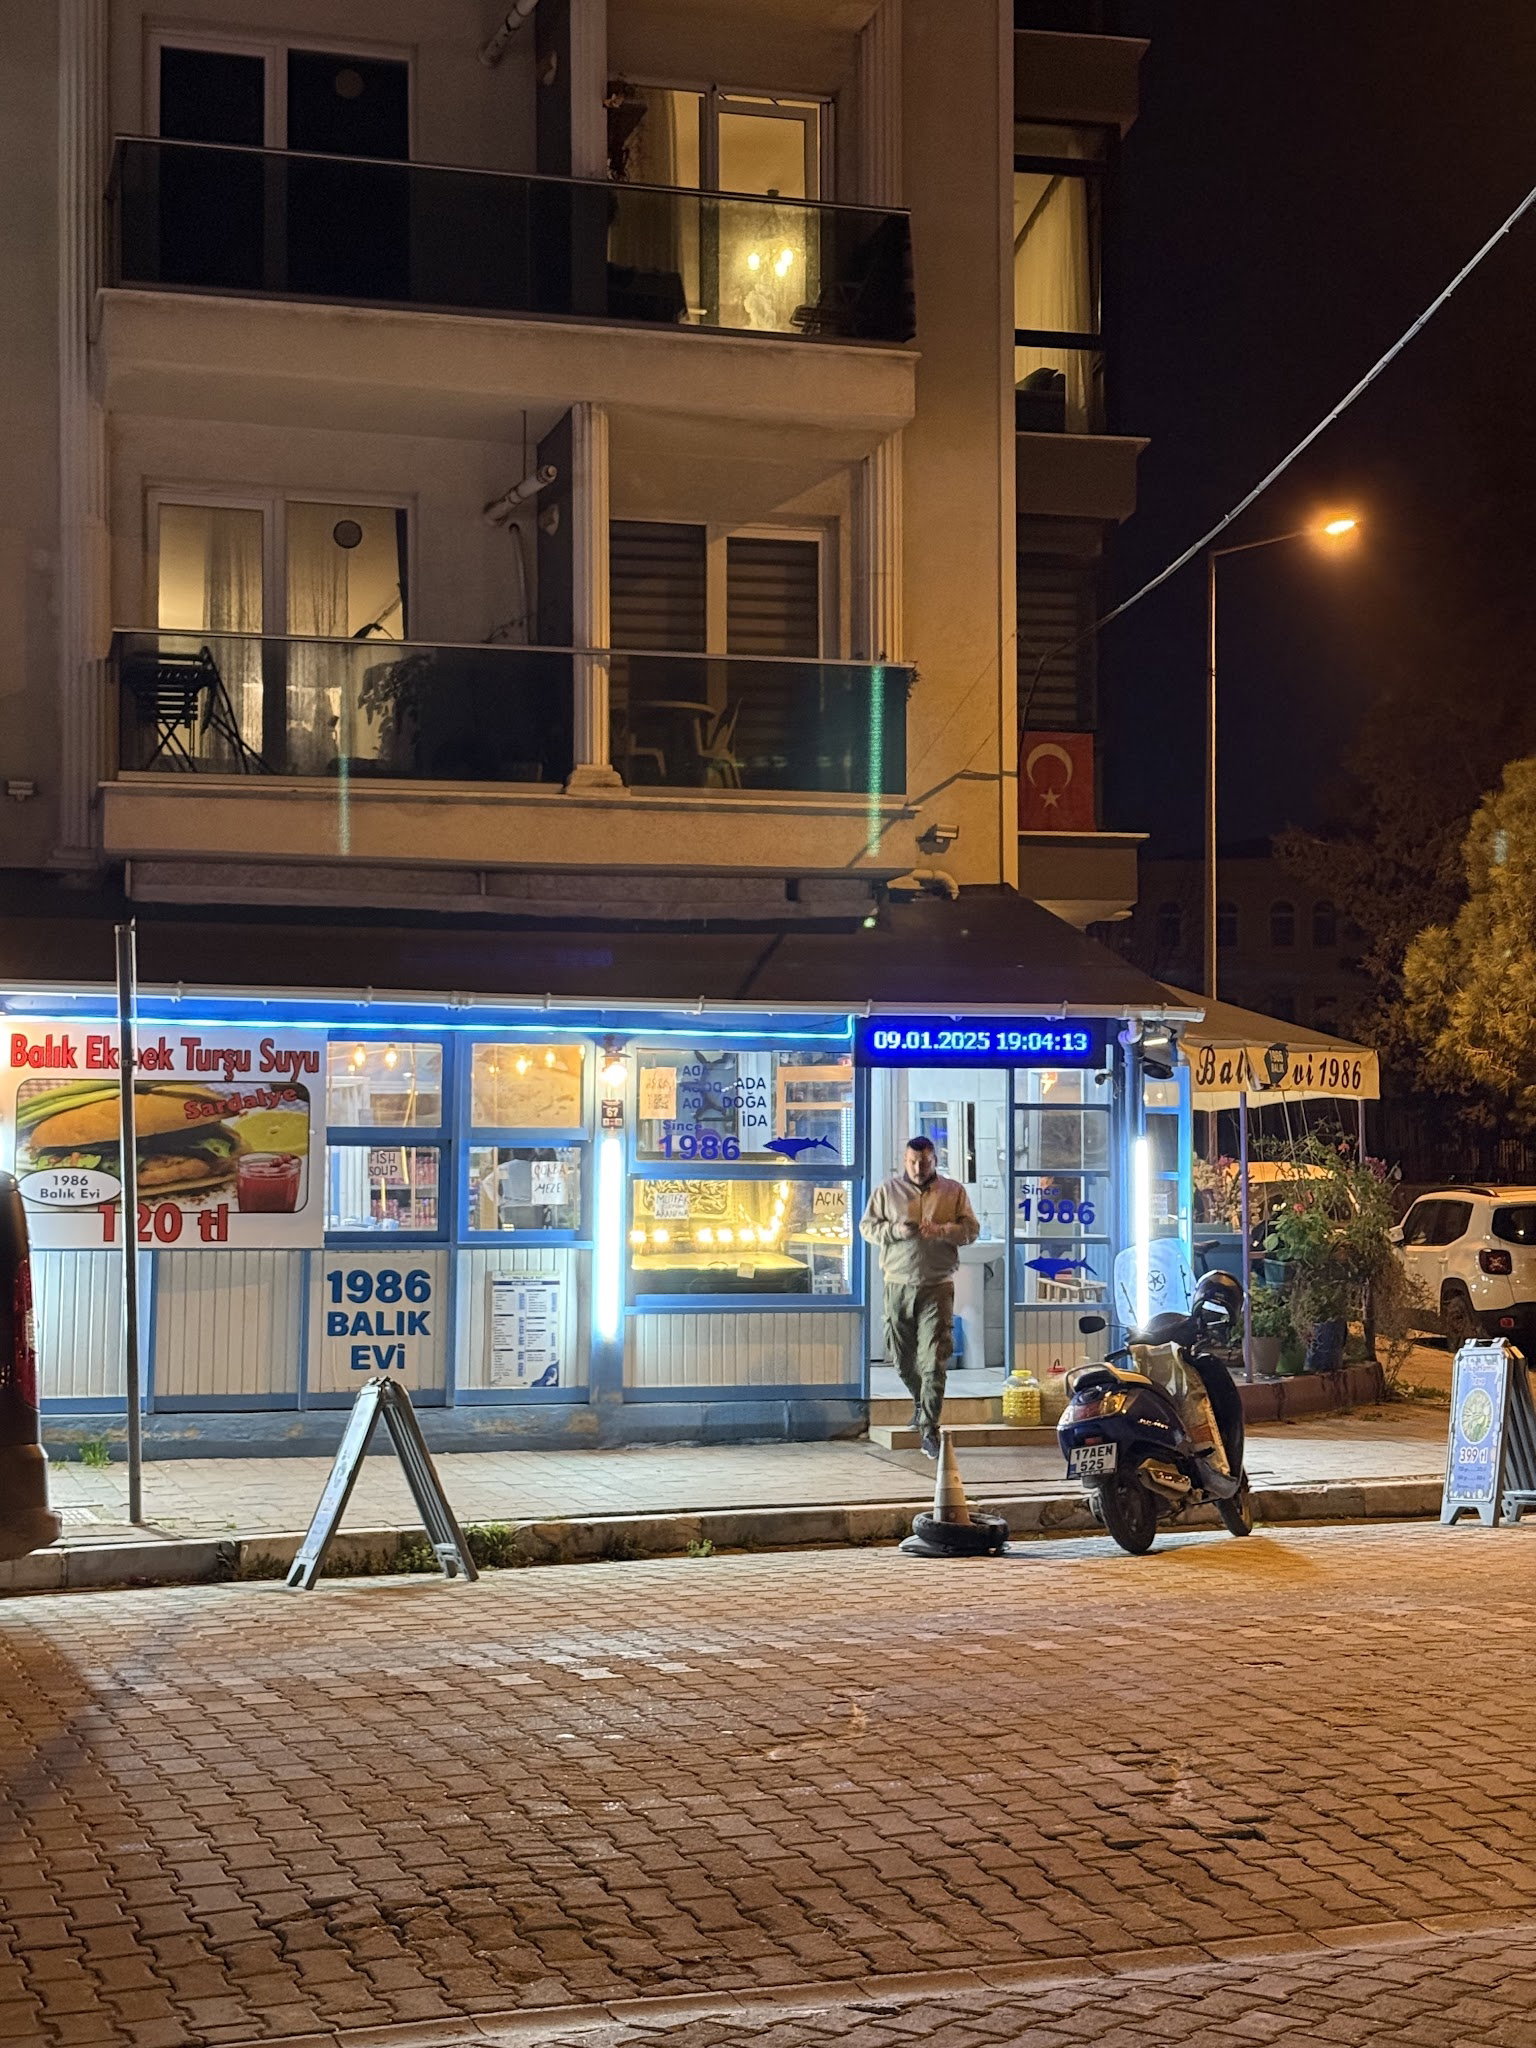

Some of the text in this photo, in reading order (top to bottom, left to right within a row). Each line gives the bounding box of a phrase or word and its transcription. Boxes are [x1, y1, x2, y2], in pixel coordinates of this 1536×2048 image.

[873, 1031, 1087, 1050] 09.01.2025 19:04:13
[11, 1033, 319, 1082] Balık Ekek Turşu Suyu
[1319, 1058, 1362, 1089] 1986
[735, 1077, 766, 1090] ADA
[184, 1088, 297, 1119] Sardalye
[722, 1091, 767, 1108] DOĞA
[663, 1120, 702, 1132] Since
[742, 1111, 768, 1127] İDA
[658, 1134, 740, 1160] 1986
[368, 1153, 397, 1164] FISH
[368, 1165, 398, 1176] SOUP
[53, 1175, 88, 1186] 1986
[40, 1188, 100, 1199] Balık Evi
[1022, 1184, 1060, 1196] Since
[816, 1192, 844, 1206] AÇIK
[1018, 1199, 1095, 1225] 1986
[198, 1203, 228, 1242] tl
[327, 1269, 431, 1304] 1986
[327, 1311, 431, 1336] BALIK
[1459, 1448, 1479, 1463] 399
[1080, 1458, 1104, 1471] 525
